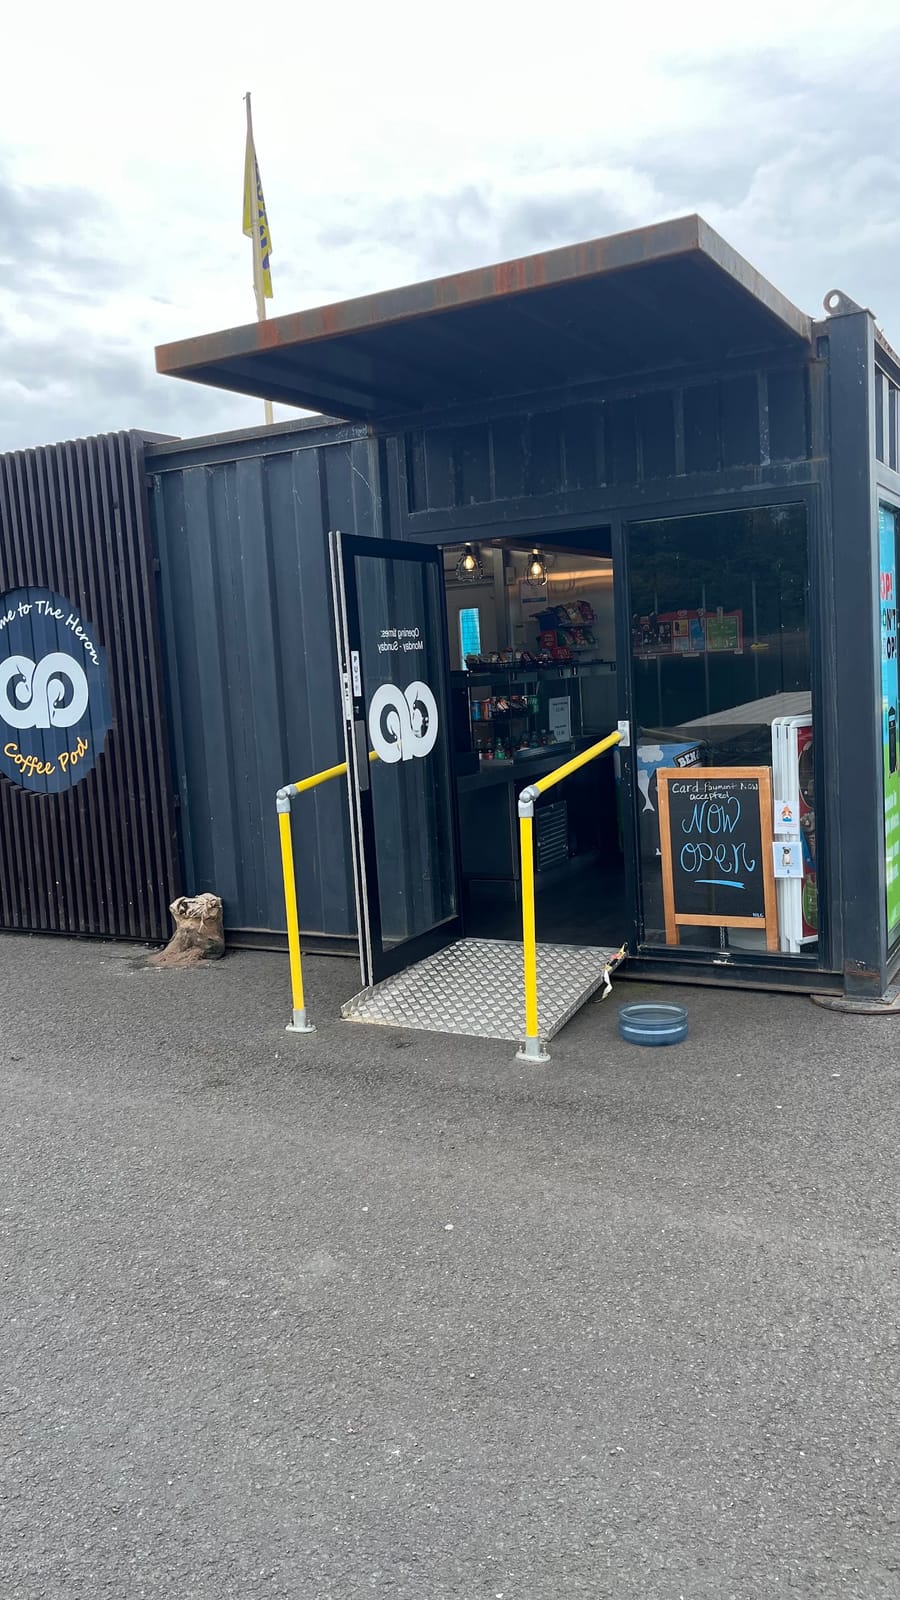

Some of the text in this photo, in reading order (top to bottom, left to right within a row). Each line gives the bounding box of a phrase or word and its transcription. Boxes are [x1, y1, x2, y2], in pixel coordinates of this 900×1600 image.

[17, 601, 33, 618] to
[34, 600, 65, 619] The
[65, 613, 100, 665] Heron
[3, 736, 88, 777] Coffee Pod
[671, 780, 699, 793] Card
[689, 791, 730, 801] accepted
